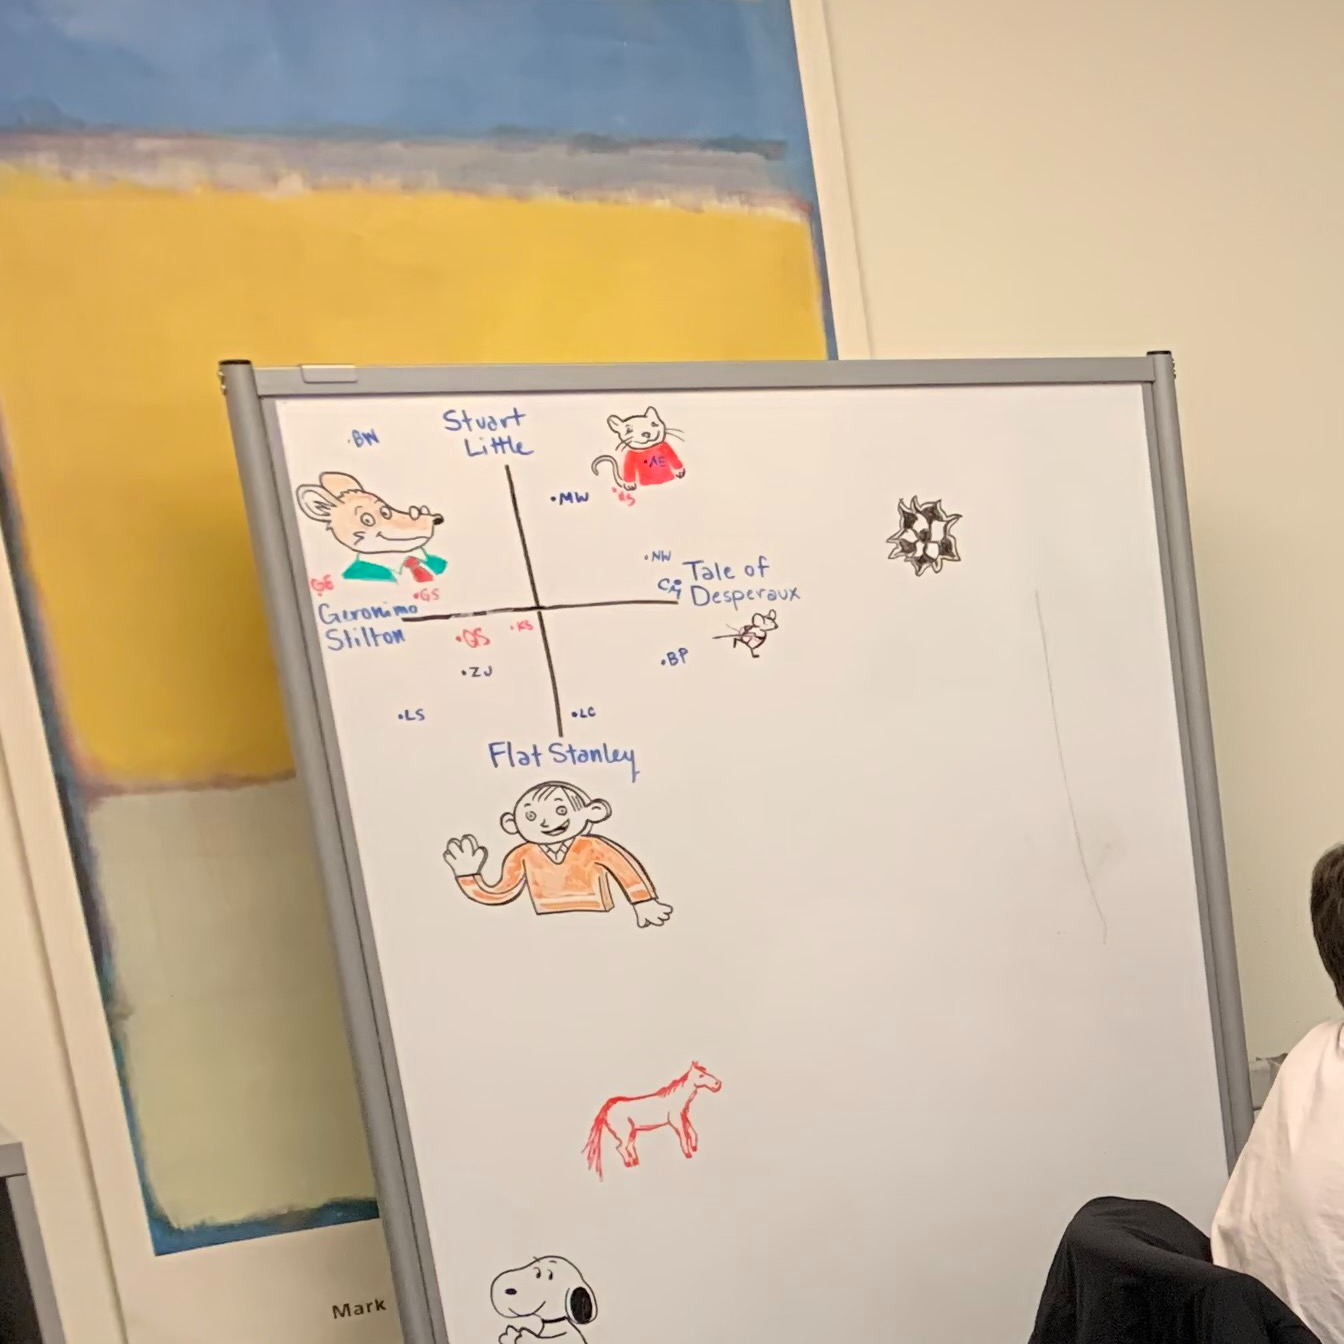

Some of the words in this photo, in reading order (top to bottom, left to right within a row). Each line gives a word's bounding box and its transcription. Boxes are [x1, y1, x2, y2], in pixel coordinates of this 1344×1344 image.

[443, 407, 526, 432] Stuart
[352, 428, 380, 448] BW
[464, 435, 534, 457] Little
[559, 491, 589, 506] MW
[652, 550, 671, 562] NW
[682, 560, 735, 581] Tale
[744, 555, 770, 578] of
[690, 585, 801, 611] Desperaux
[318, 602, 418, 625] Geronimo
[326, 626, 405, 651] Stilton
[666, 647, 689, 666] BP
[404, 708, 426, 722] LS
[580, 706, 597, 718] LC
[488, 741, 542, 768] Flat
[548, 742, 640, 783] Stanley
[331, 1298, 387, 1320] Mark
